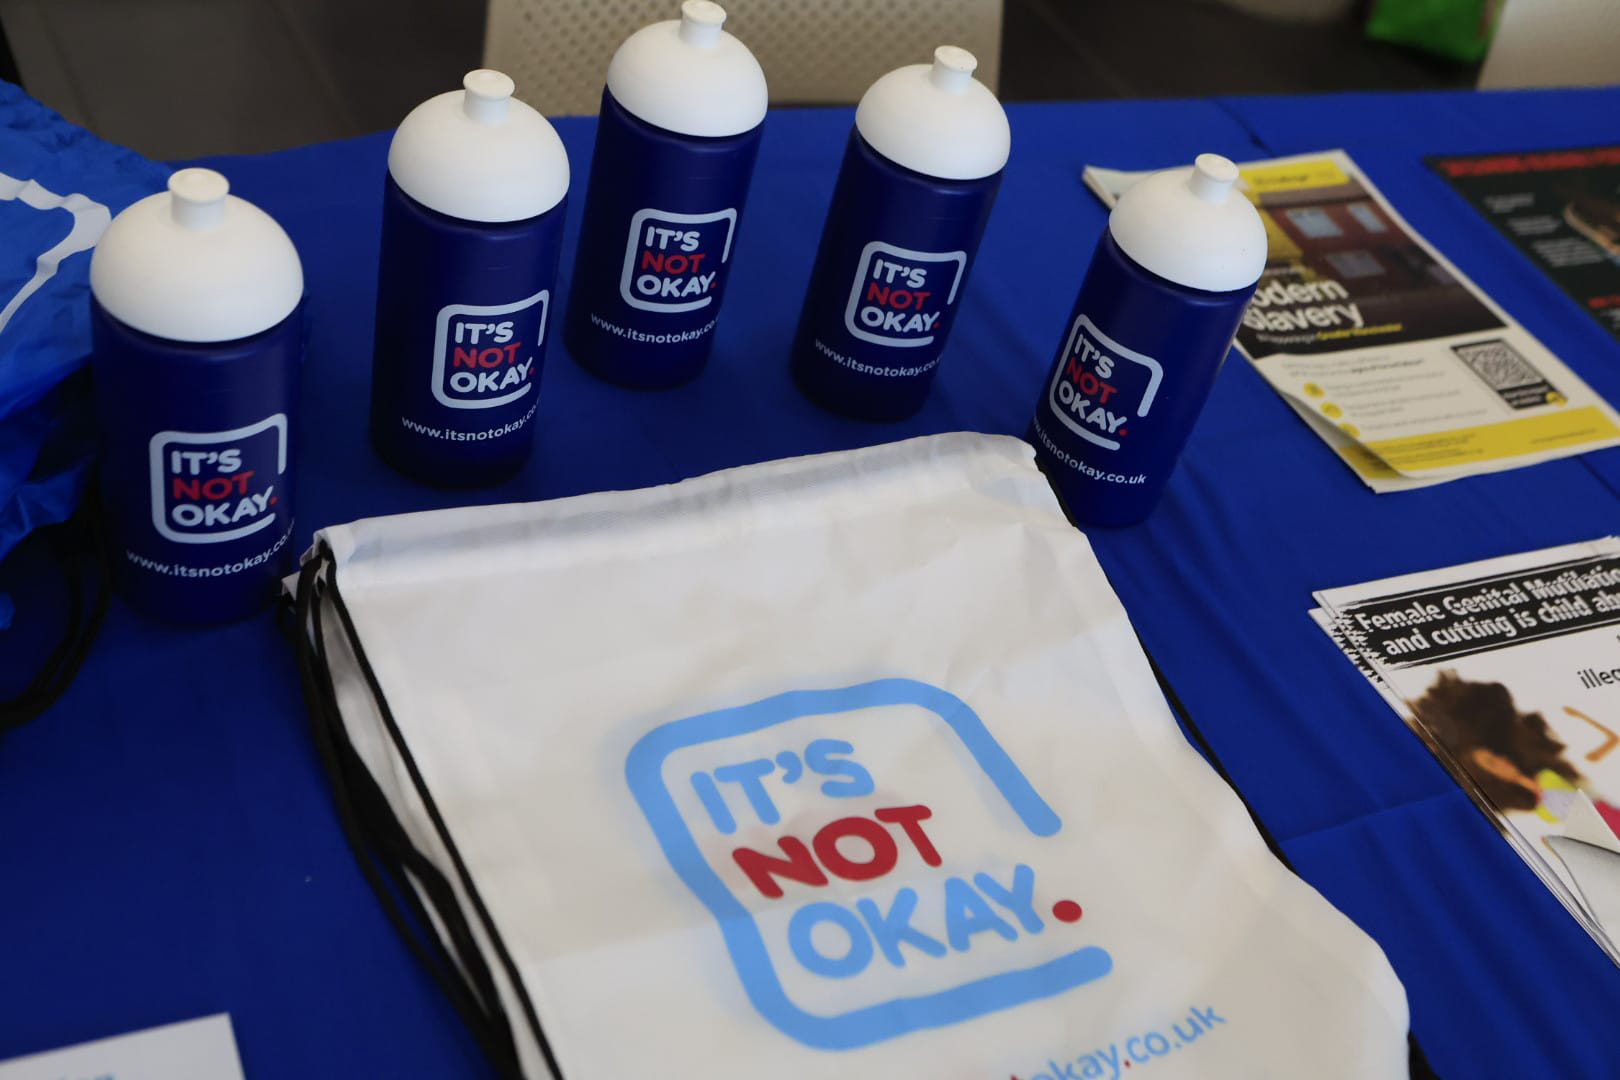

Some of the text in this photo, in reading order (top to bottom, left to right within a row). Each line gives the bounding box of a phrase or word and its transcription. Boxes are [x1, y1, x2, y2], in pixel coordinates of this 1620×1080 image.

[645, 226, 700, 252] IT'S
[641, 250, 706, 275] NOT
[872, 259, 928, 289] IT'S
[637, 271, 716, 298] OKAY.
[867, 281, 931, 311] NOT
[1251, 280, 1348, 307] odern
[455, 321, 514, 344] IT'S
[860, 306, 940, 332] OKAY.
[453, 342, 522, 369] NOT
[1074, 334, 1115, 379] IT'S
[450, 356, 536, 393] OKAY.
[1066, 357, 1118, 404] NOT
[1058, 380, 1128, 437] OKAY.
[171, 448, 242, 475] IT'S
[172, 470, 254, 500] NOT
[171, 485, 279, 527] OKAY.
[1355, 601, 1446, 632] Female
[1443, 582, 1530, 616] Genital
[1382, 628, 1431, 656] and
[1431, 616, 1516, 646] cutting
[1509, 608, 1538, 629] is
[1539, 595, 1593, 623] child
[689, 738, 875, 835] IT'S
[732, 804, 943, 899] NOT
[787, 863, 1083, 979] OKAY.
